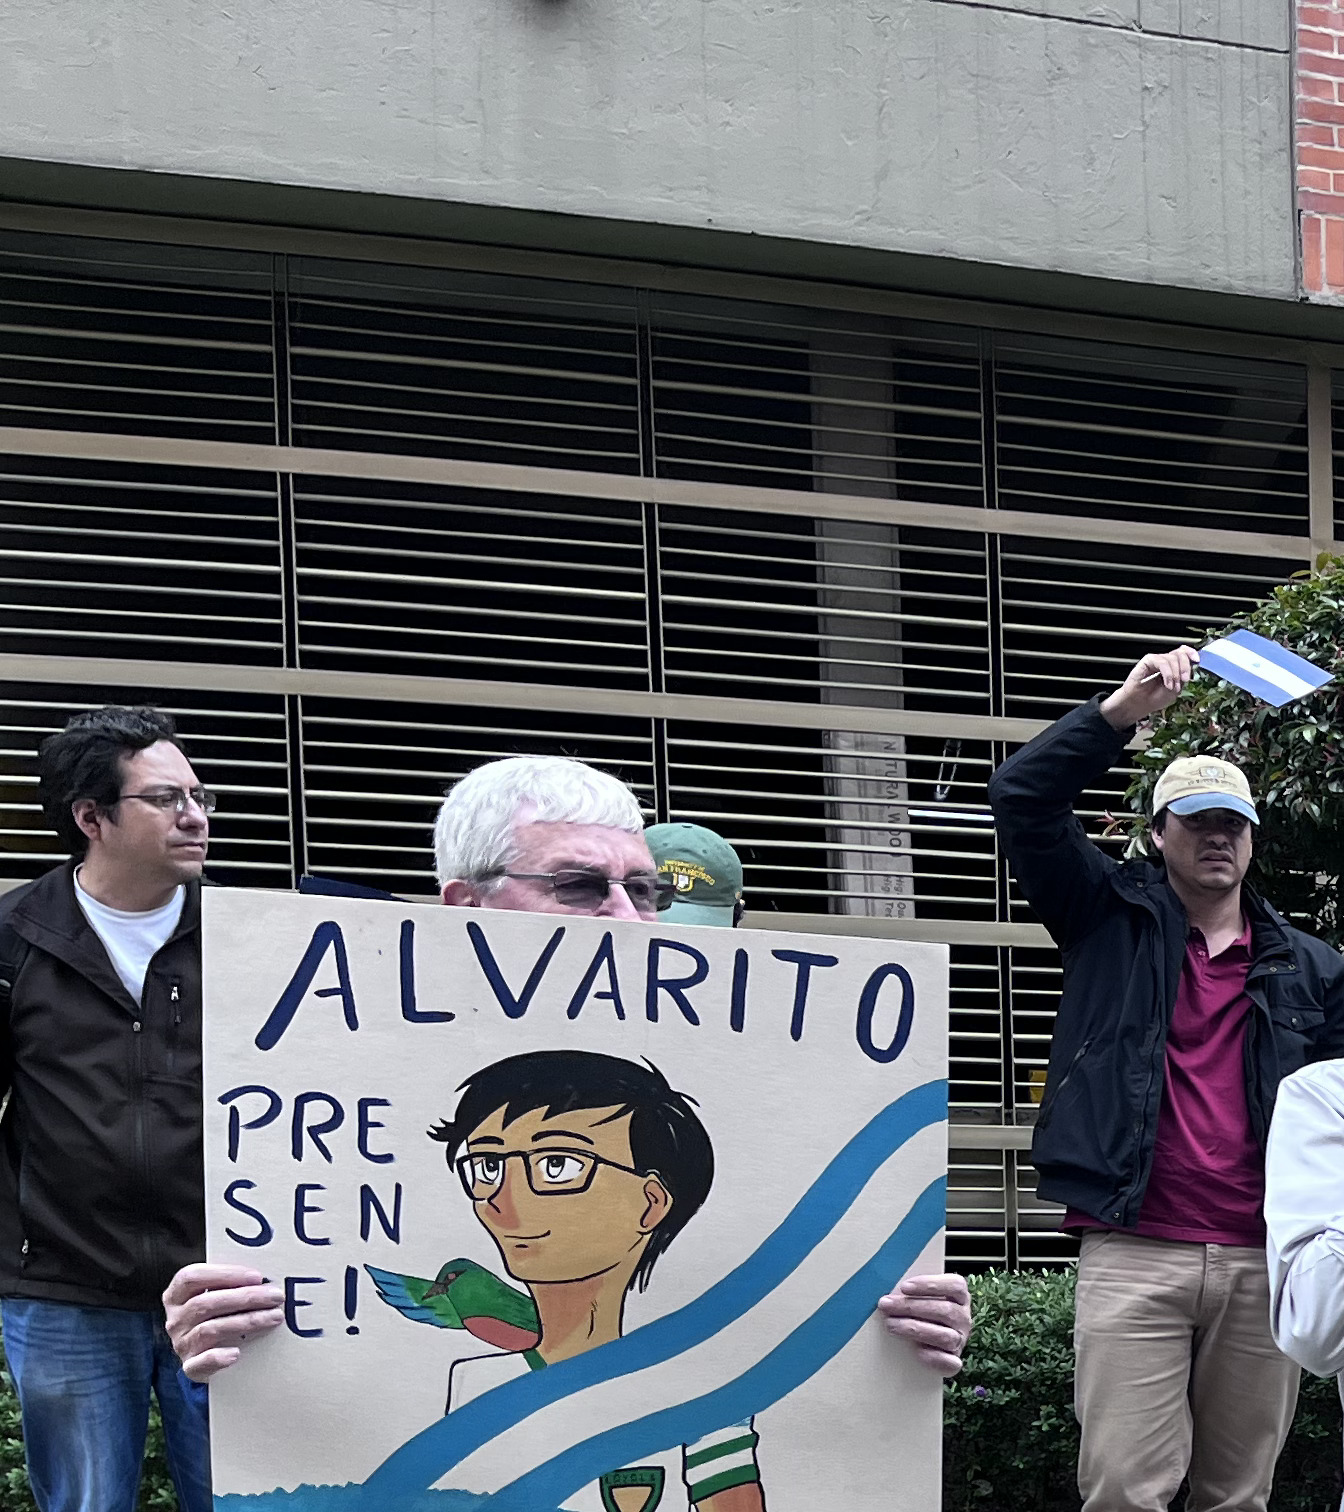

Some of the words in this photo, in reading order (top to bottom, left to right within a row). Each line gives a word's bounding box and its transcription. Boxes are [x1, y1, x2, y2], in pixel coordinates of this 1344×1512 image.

[255, 920, 915, 1063] ALVARITO
[217, 1085, 394, 1164] PRE
[224, 1180, 403, 1247] SEN
